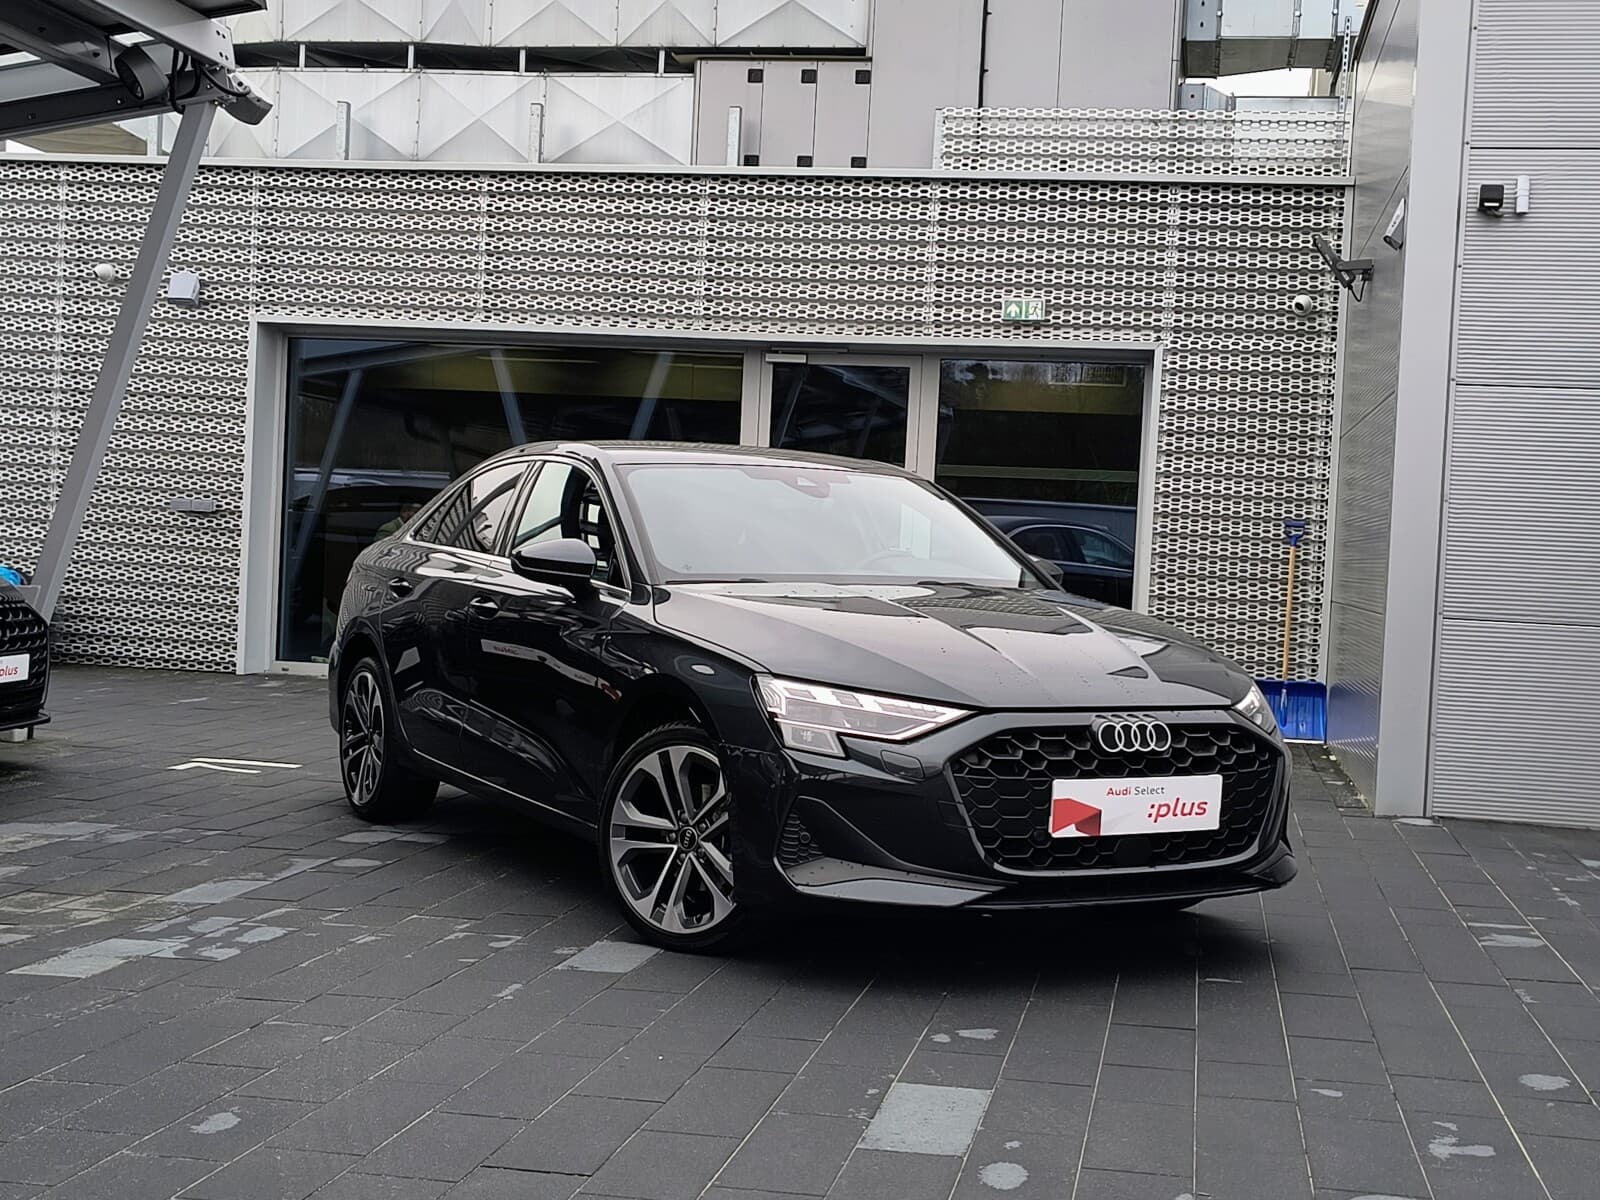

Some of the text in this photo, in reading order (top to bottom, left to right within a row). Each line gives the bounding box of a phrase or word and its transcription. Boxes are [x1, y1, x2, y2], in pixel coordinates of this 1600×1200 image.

[1106, 786, 1165, 796] Audi Select
[1147, 797, 1208, 823] :plus
